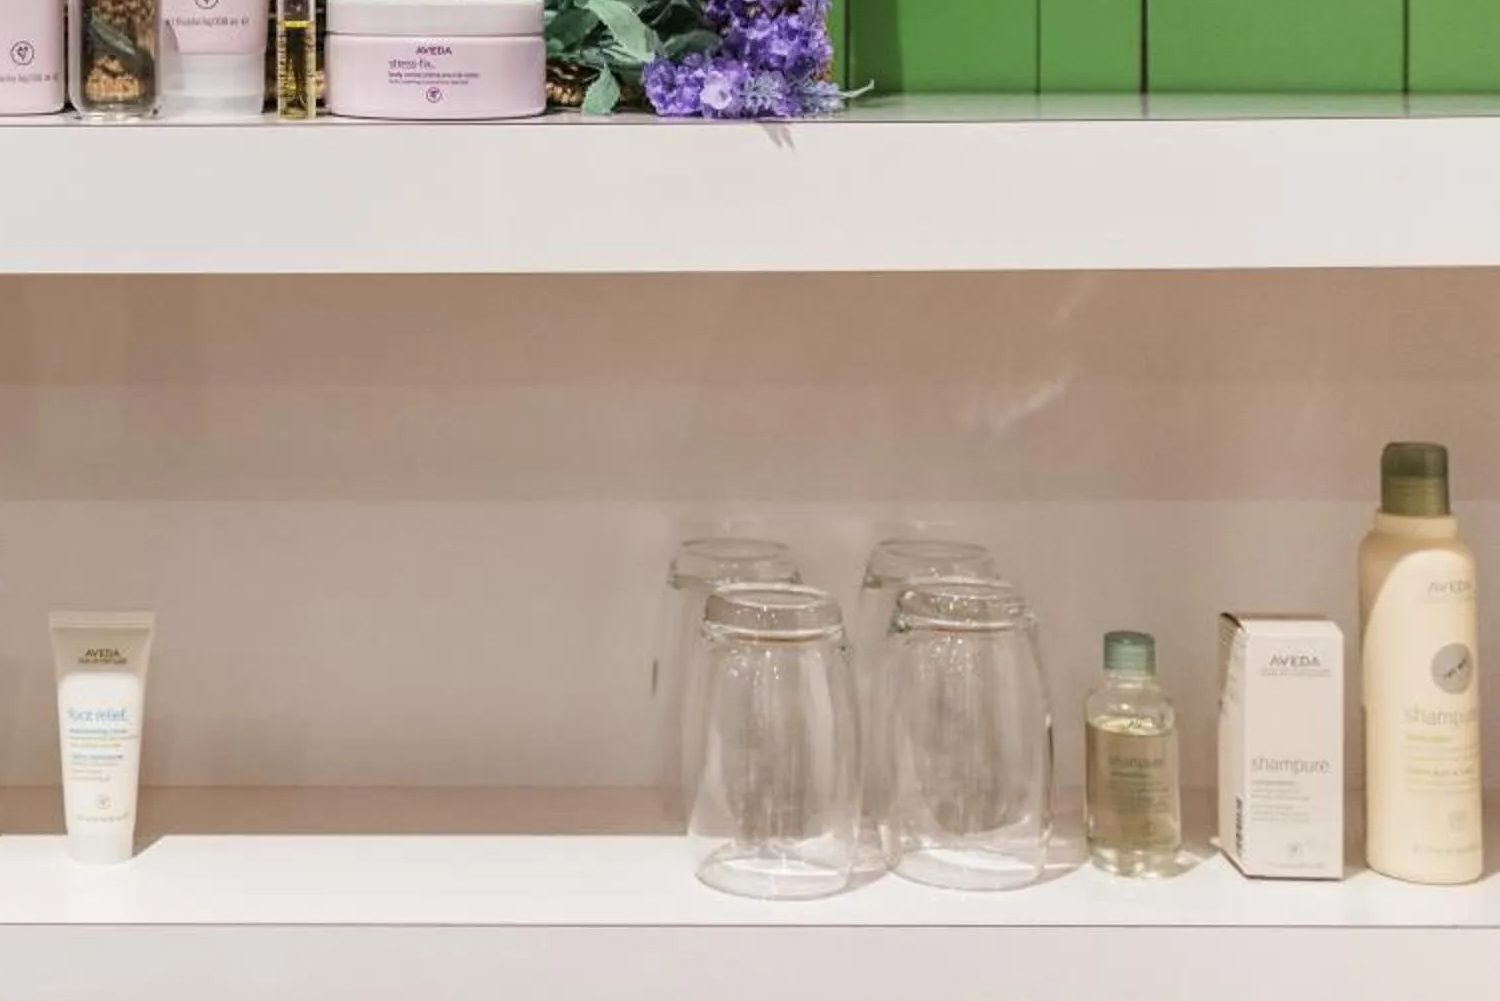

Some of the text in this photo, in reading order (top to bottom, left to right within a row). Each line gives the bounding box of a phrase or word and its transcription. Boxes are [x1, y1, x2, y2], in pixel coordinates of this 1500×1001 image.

[415, 45, 453, 55] AVEDA
[84, 648, 121, 658] AVEDA
[1268, 654, 1321, 668] AVEDA
[1250, 755, 1332, 775] shampure
